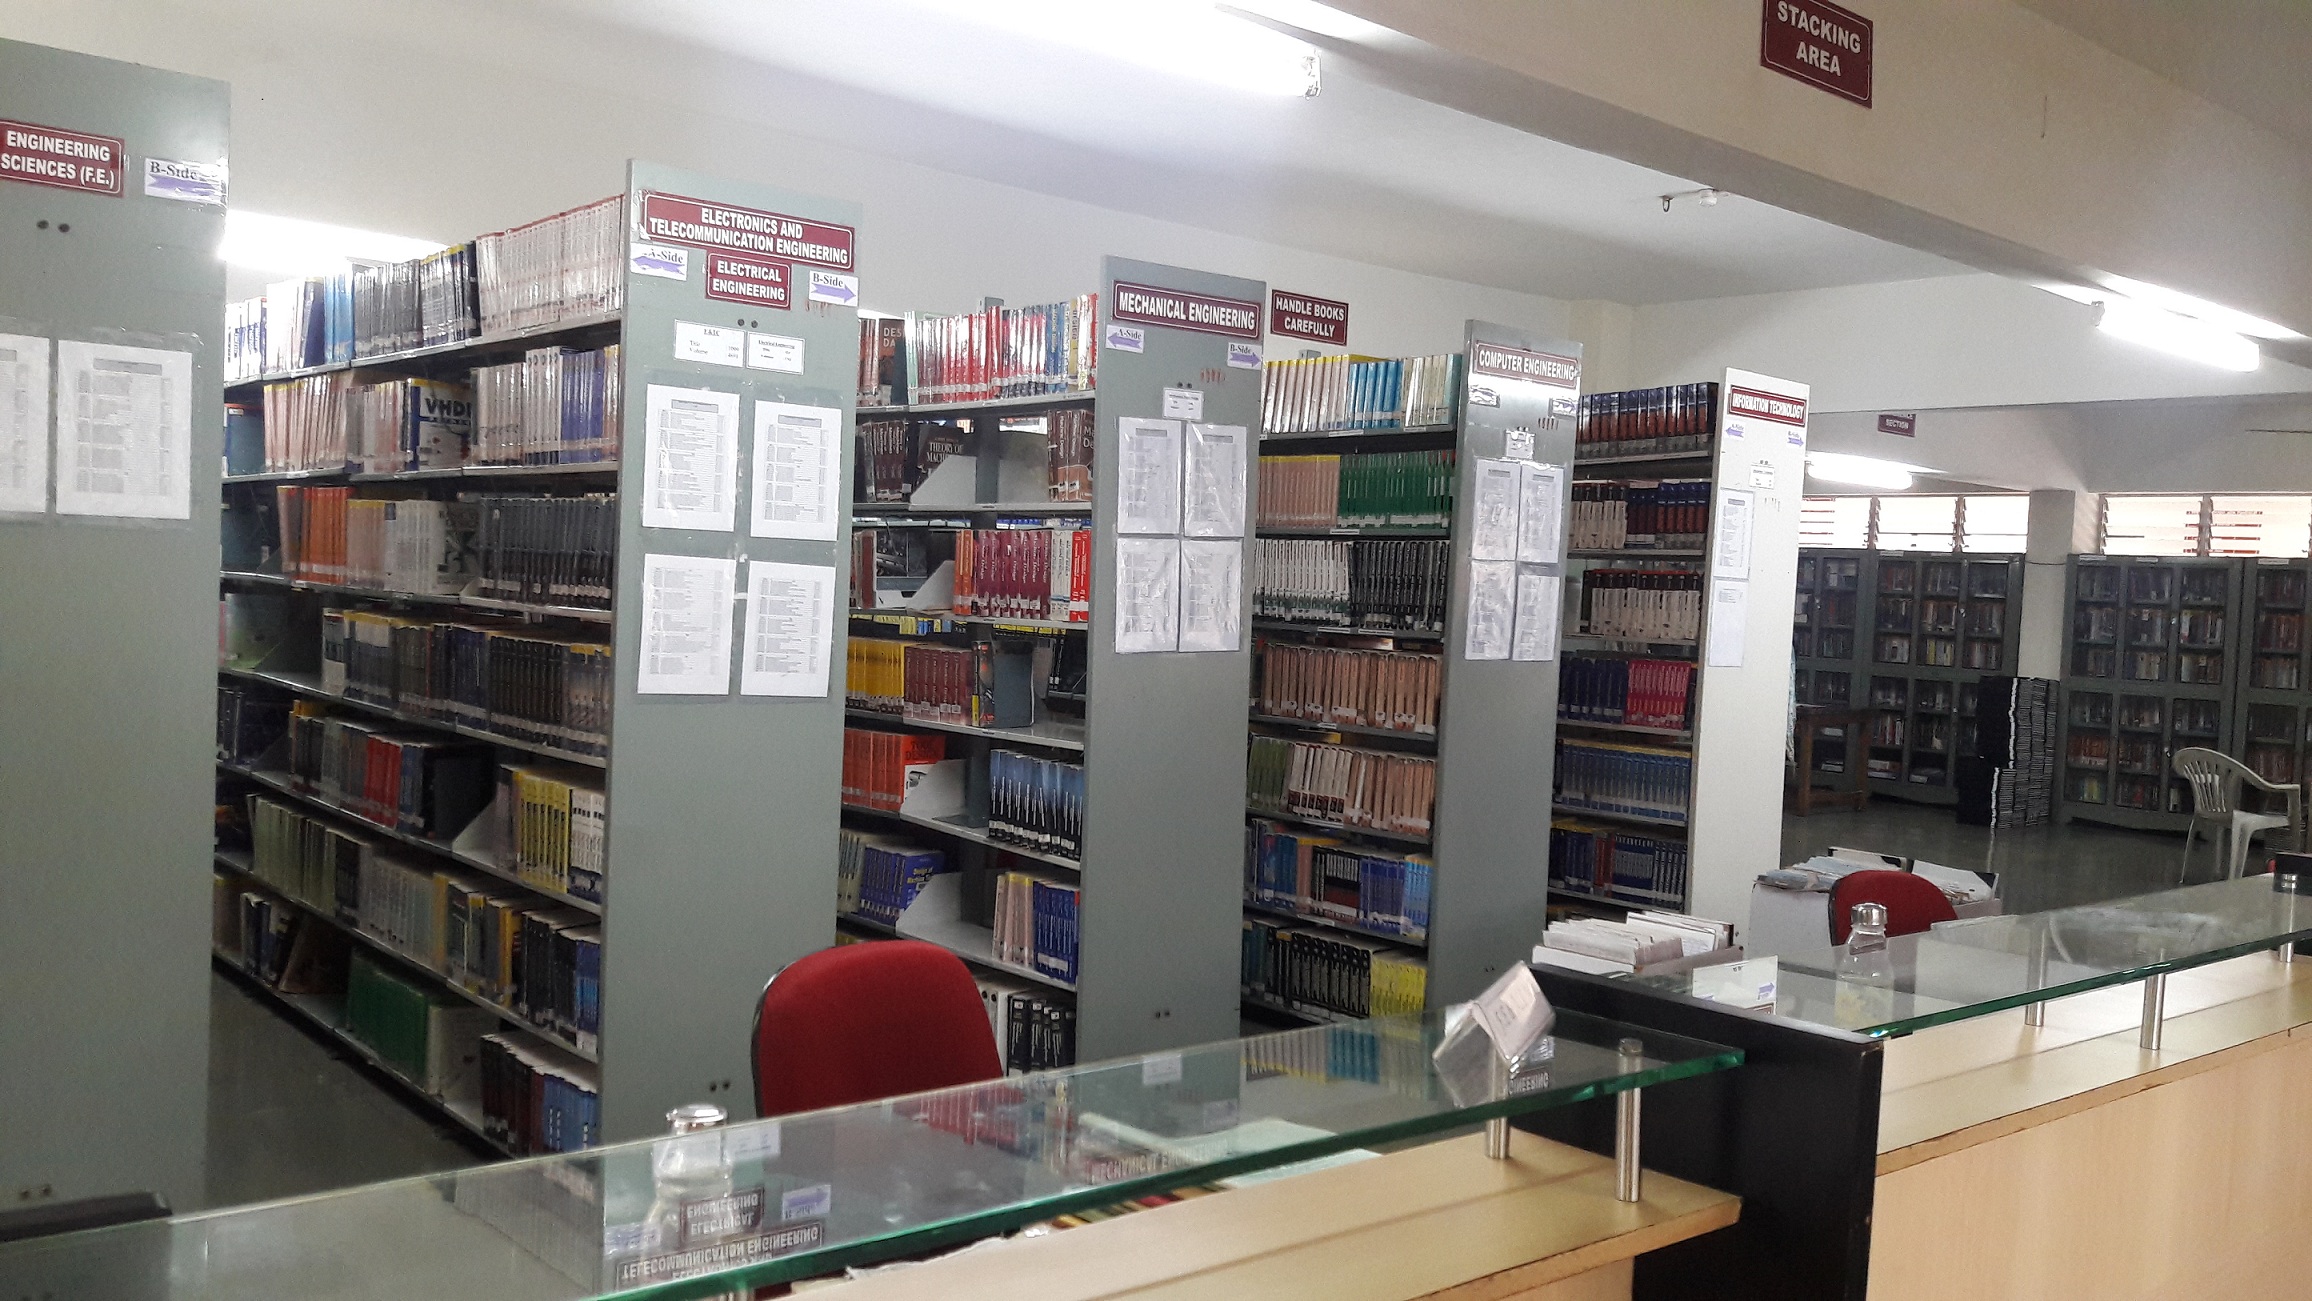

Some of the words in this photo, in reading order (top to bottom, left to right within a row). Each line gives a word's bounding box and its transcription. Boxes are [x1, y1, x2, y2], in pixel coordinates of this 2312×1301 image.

[1777, 1, 1861, 54] STACKING
[1796, 41, 1841, 76] AREA
[6, 130, 110, 162] ENGINEERING
[0, 153, 77, 180] SCIENCES
[80, 165, 115, 189] (F.E.)
[150, 161, 198, 180] B-Side
[701, 207, 778, 234] ELECTRONICS
[780, 222, 803, 239] AND
[649, 217, 774, 253] TELECOMMUNICATION
[776, 239, 848, 264] ENGINEERING
[717, 260, 782, 283] ELECTRICAL
[812, 272, 844, 288] B-Side
[712, 278, 785, 301] ENGINEERING
[1119, 291, 1187, 321] MECHANICAL
[1188, 304, 1255, 330] ENGINEERING
[1275, 297, 1312, 316] HANDLE
[1314, 304, 1345, 321] BOOKS
[1117, 328, 1142, 340] A-Side
[1284, 317, 1335, 338] CAREFULLY
[1479, 350, 1522, 373] COMPUTER
[1523, 358, 1575, 381] ENGINEERING
[1732, 393, 1769, 413] INFORMATION
[1770, 401, 1804, 419] TECHNOLOGY
